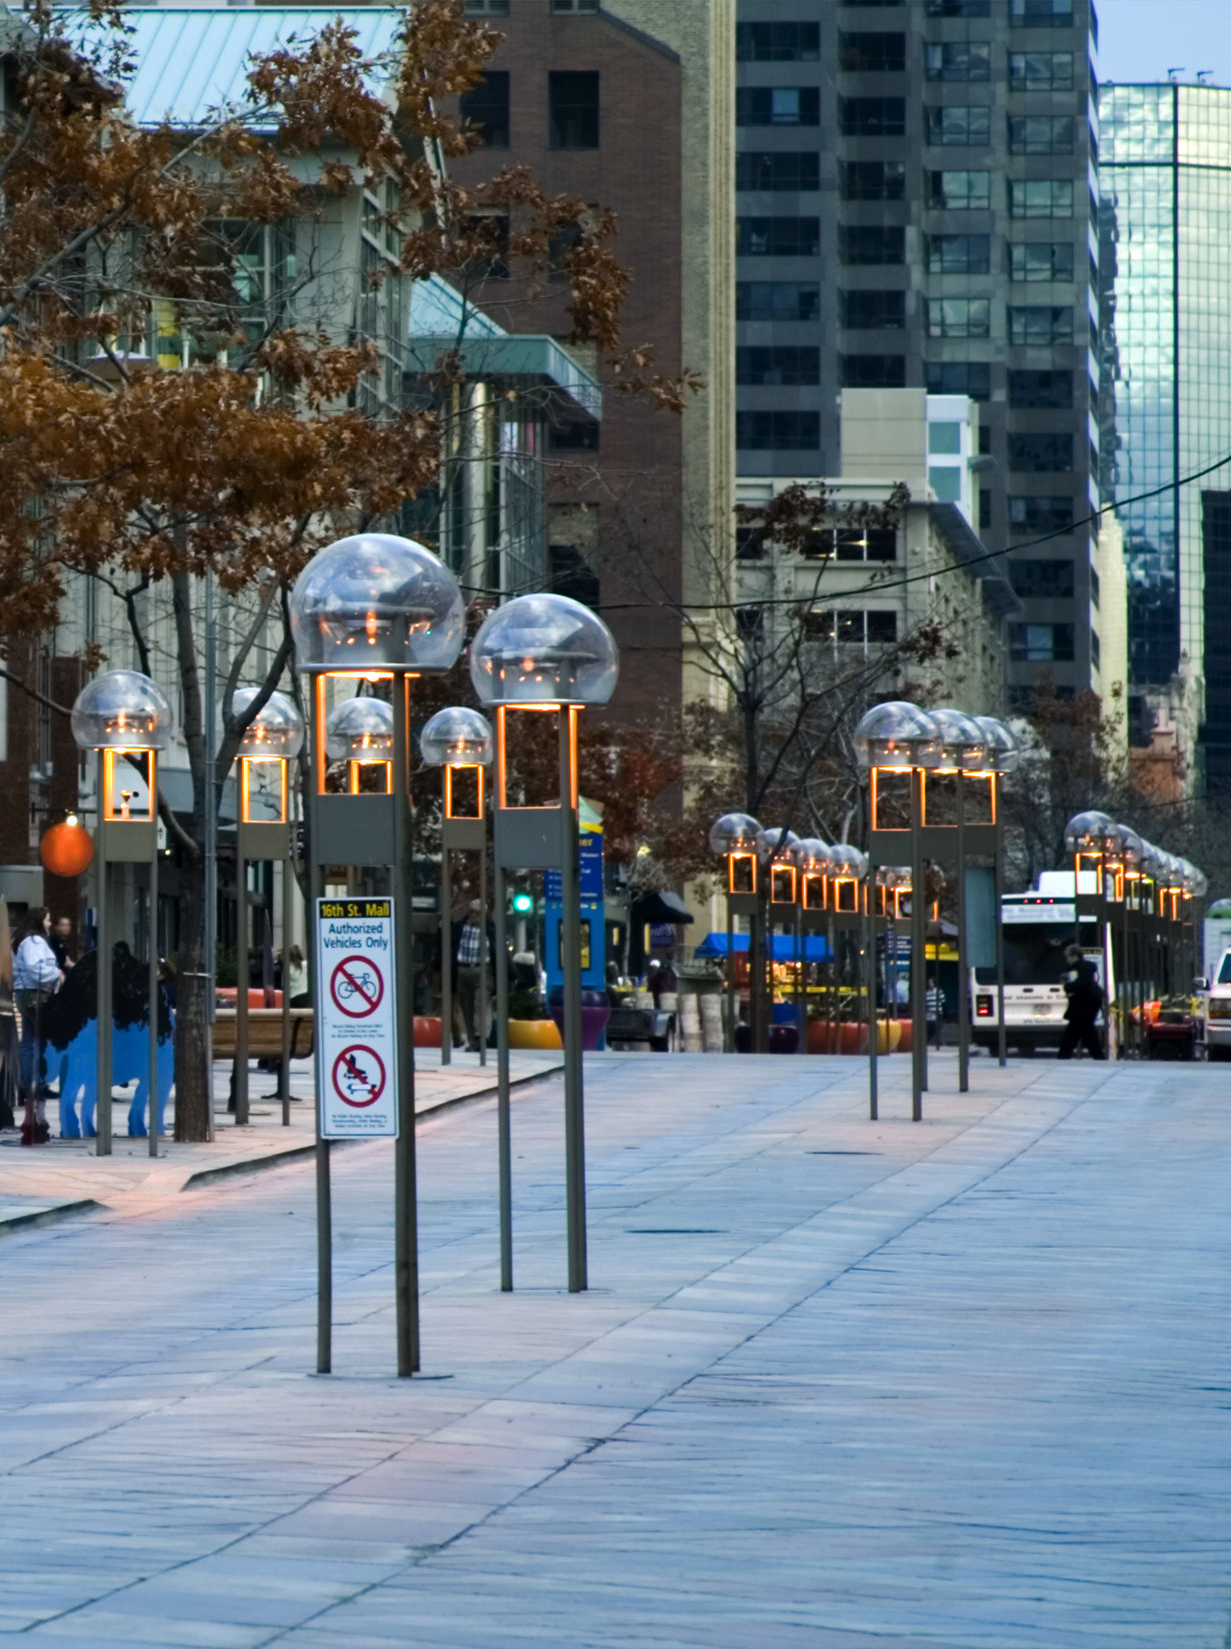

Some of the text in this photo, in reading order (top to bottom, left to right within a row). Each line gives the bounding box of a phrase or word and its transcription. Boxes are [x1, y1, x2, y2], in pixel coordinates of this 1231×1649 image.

[321, 903, 389, 916] 16th St. Mall
[329, 922, 383, 934] Authorized
[323, 936, 388, 951] Vehicles Only
